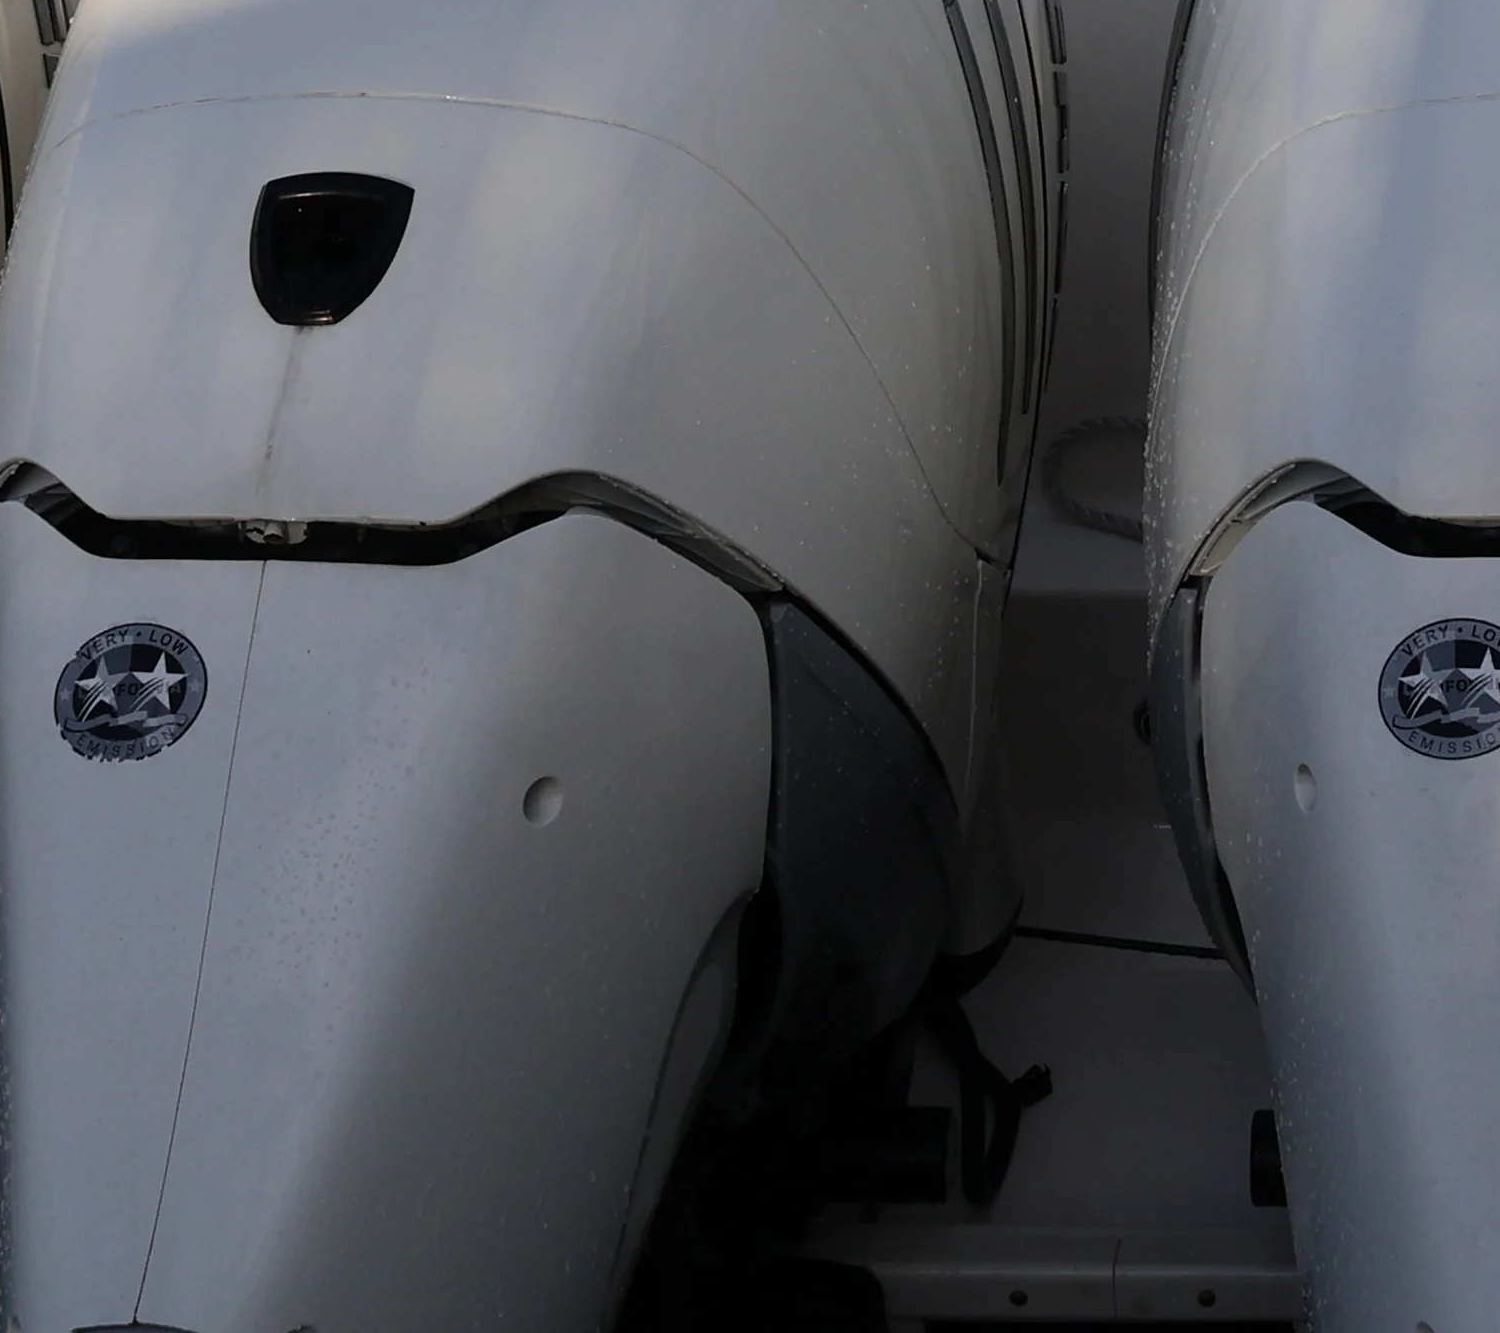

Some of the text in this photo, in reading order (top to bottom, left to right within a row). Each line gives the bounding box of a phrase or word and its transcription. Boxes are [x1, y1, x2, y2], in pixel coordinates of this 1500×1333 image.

[81, 628, 190, 660] VERY LOW
[1400, 624, 1449, 656] VERY
[76, 729, 177, 758] EMISSION
